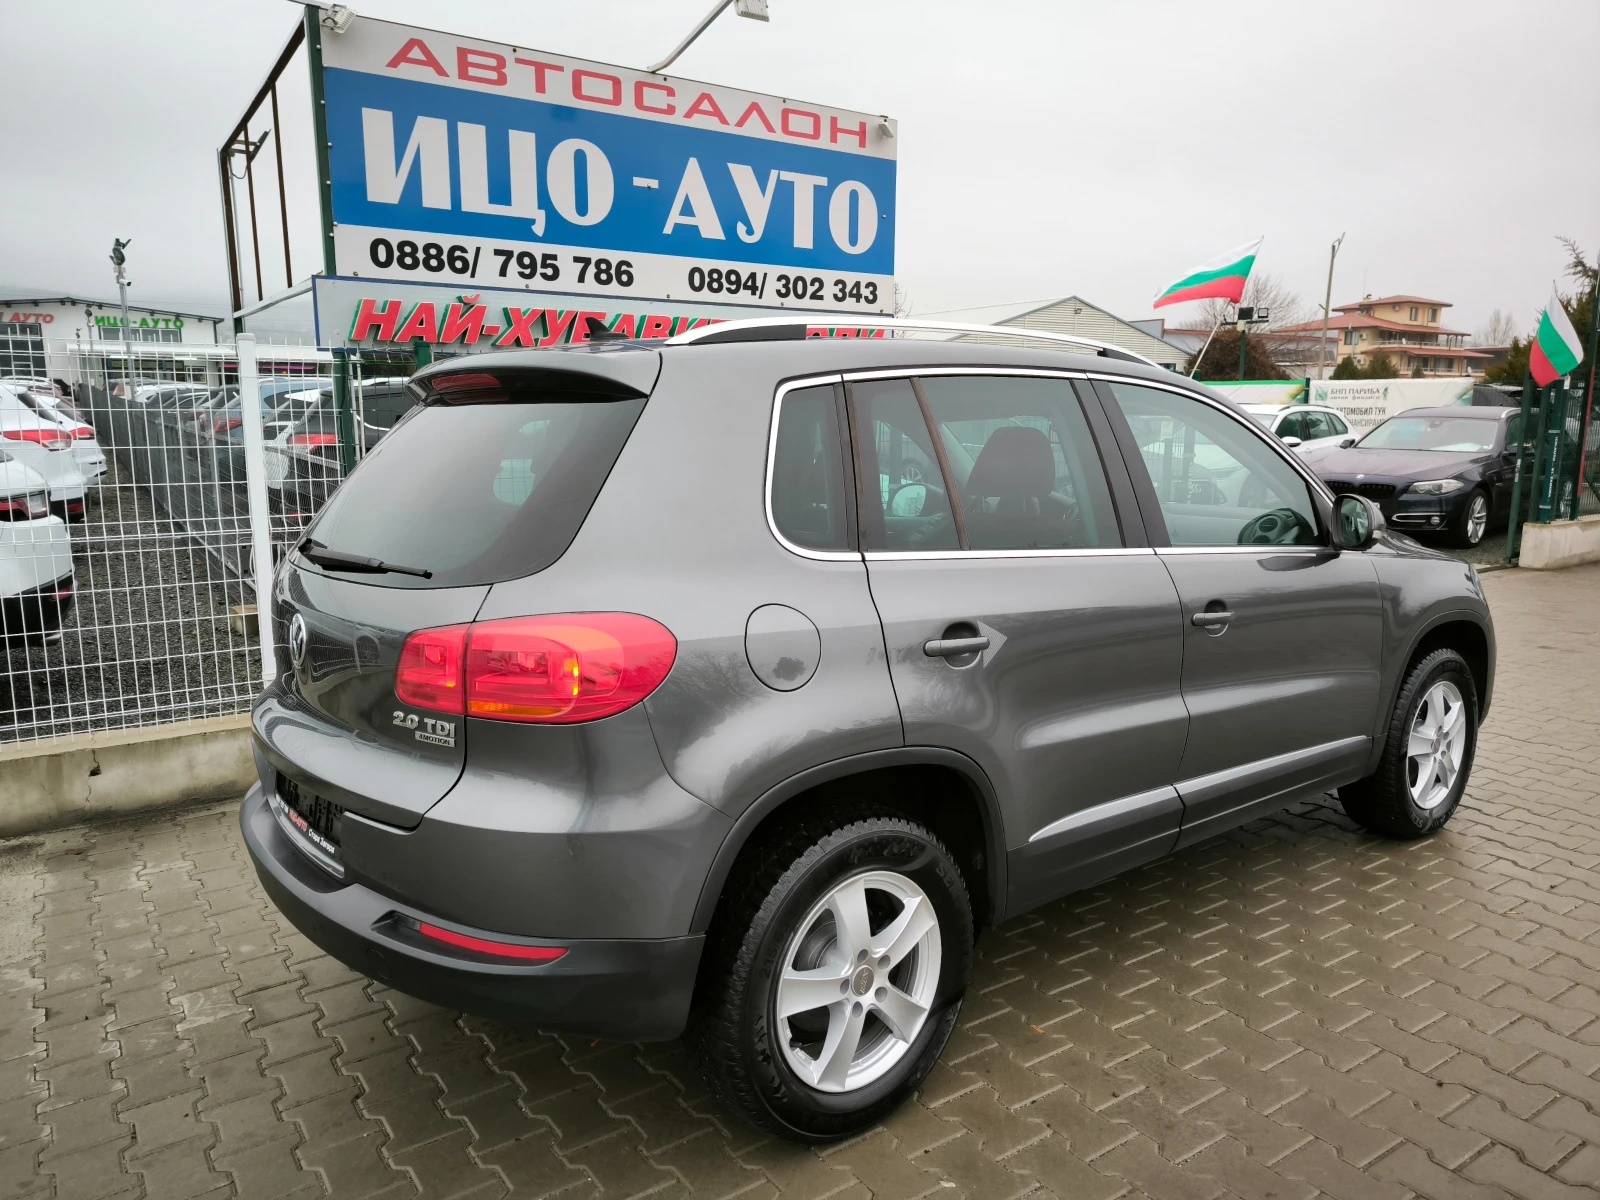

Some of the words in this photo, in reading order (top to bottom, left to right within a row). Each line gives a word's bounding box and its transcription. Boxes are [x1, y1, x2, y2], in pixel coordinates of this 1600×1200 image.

[385, 37, 867, 149] АВТОСАЛОН
[369, 237, 482, 279] 0886/
[493, 248, 561, 282] 795
[572, 255, 635, 287] 786
[687, 266, 768, 299] 0894/
[775, 274, 825, 301] 302
[832, 279, 879, 304] 343
[1374, 407, 1386, 415] ТУК
[393, 709, 419, 730] 2.0
[424, 718, 455, 737] TDI
[418, 733, 451, 746] 4MOTION
